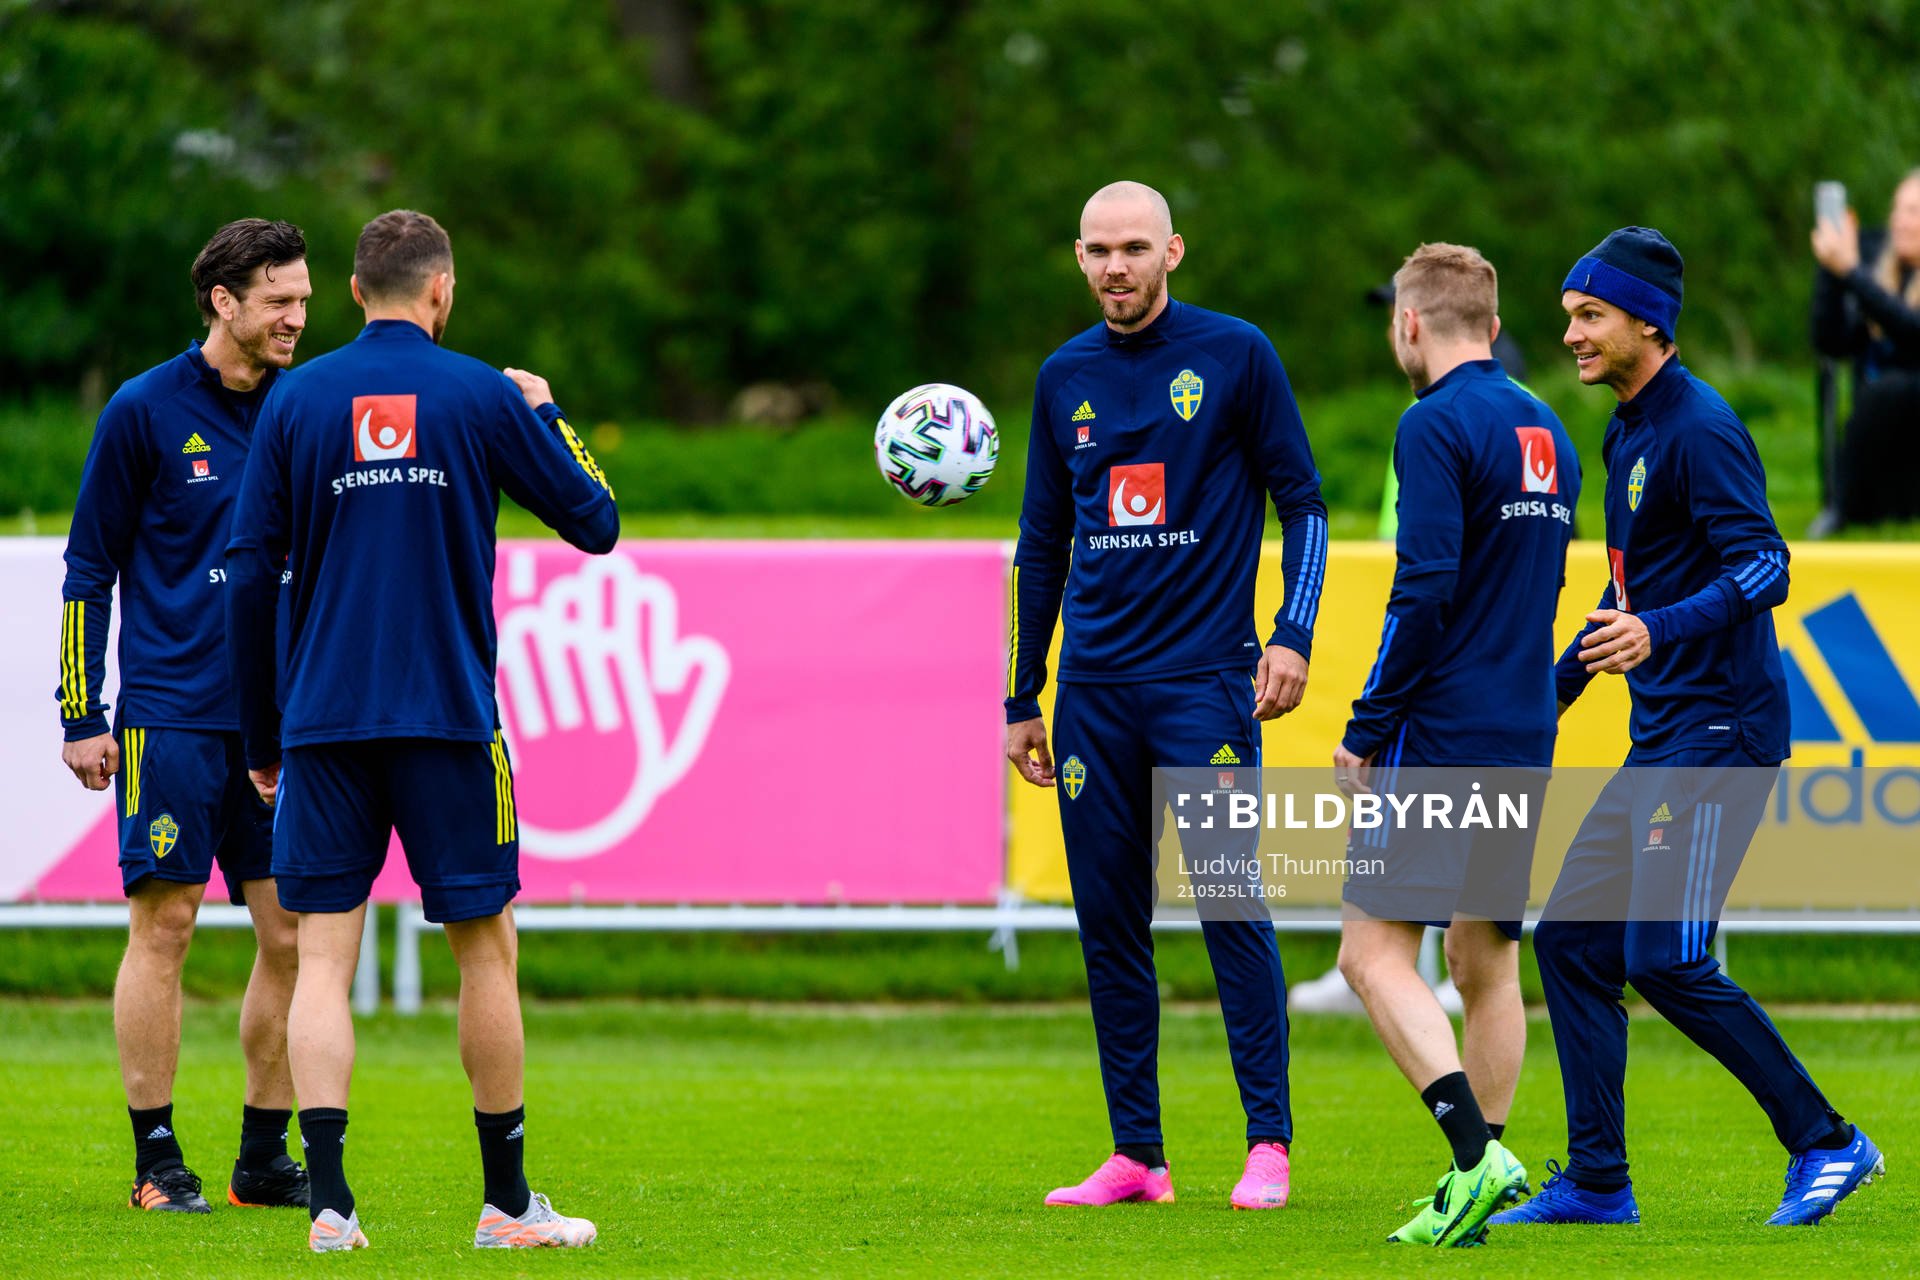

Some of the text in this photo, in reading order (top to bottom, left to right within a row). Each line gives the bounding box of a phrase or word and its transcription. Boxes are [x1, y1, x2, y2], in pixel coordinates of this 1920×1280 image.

[182, 444, 212, 454] adidas
[407, 466, 449, 487] SPEL
[1089, 529, 1200, 550] SVENSKA SPEL
[1209, 756, 1241, 765] adidas
